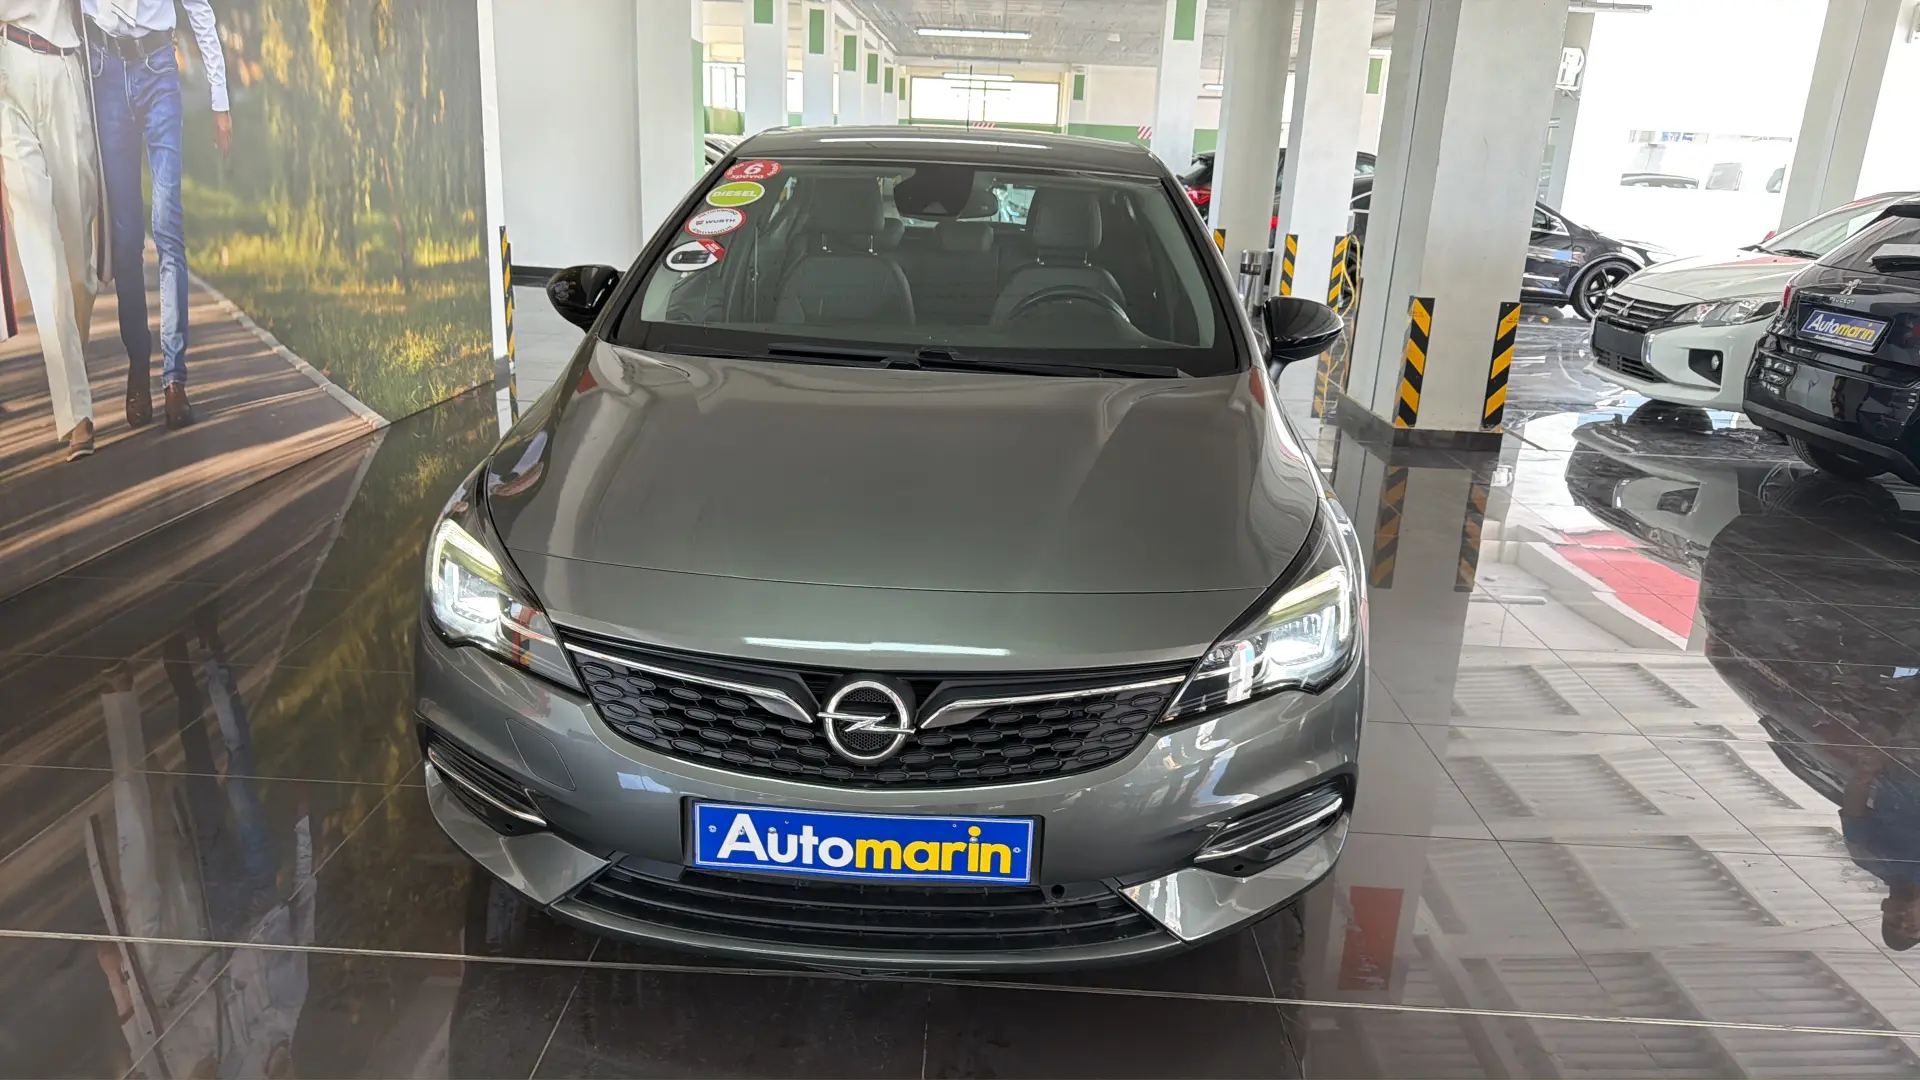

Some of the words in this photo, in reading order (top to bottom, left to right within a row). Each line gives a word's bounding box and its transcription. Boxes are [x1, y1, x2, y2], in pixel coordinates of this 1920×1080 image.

[744, 163, 764, 175] 6
[1807, 313, 1876, 341] Automarin
[717, 813, 1012, 874] Automarin
